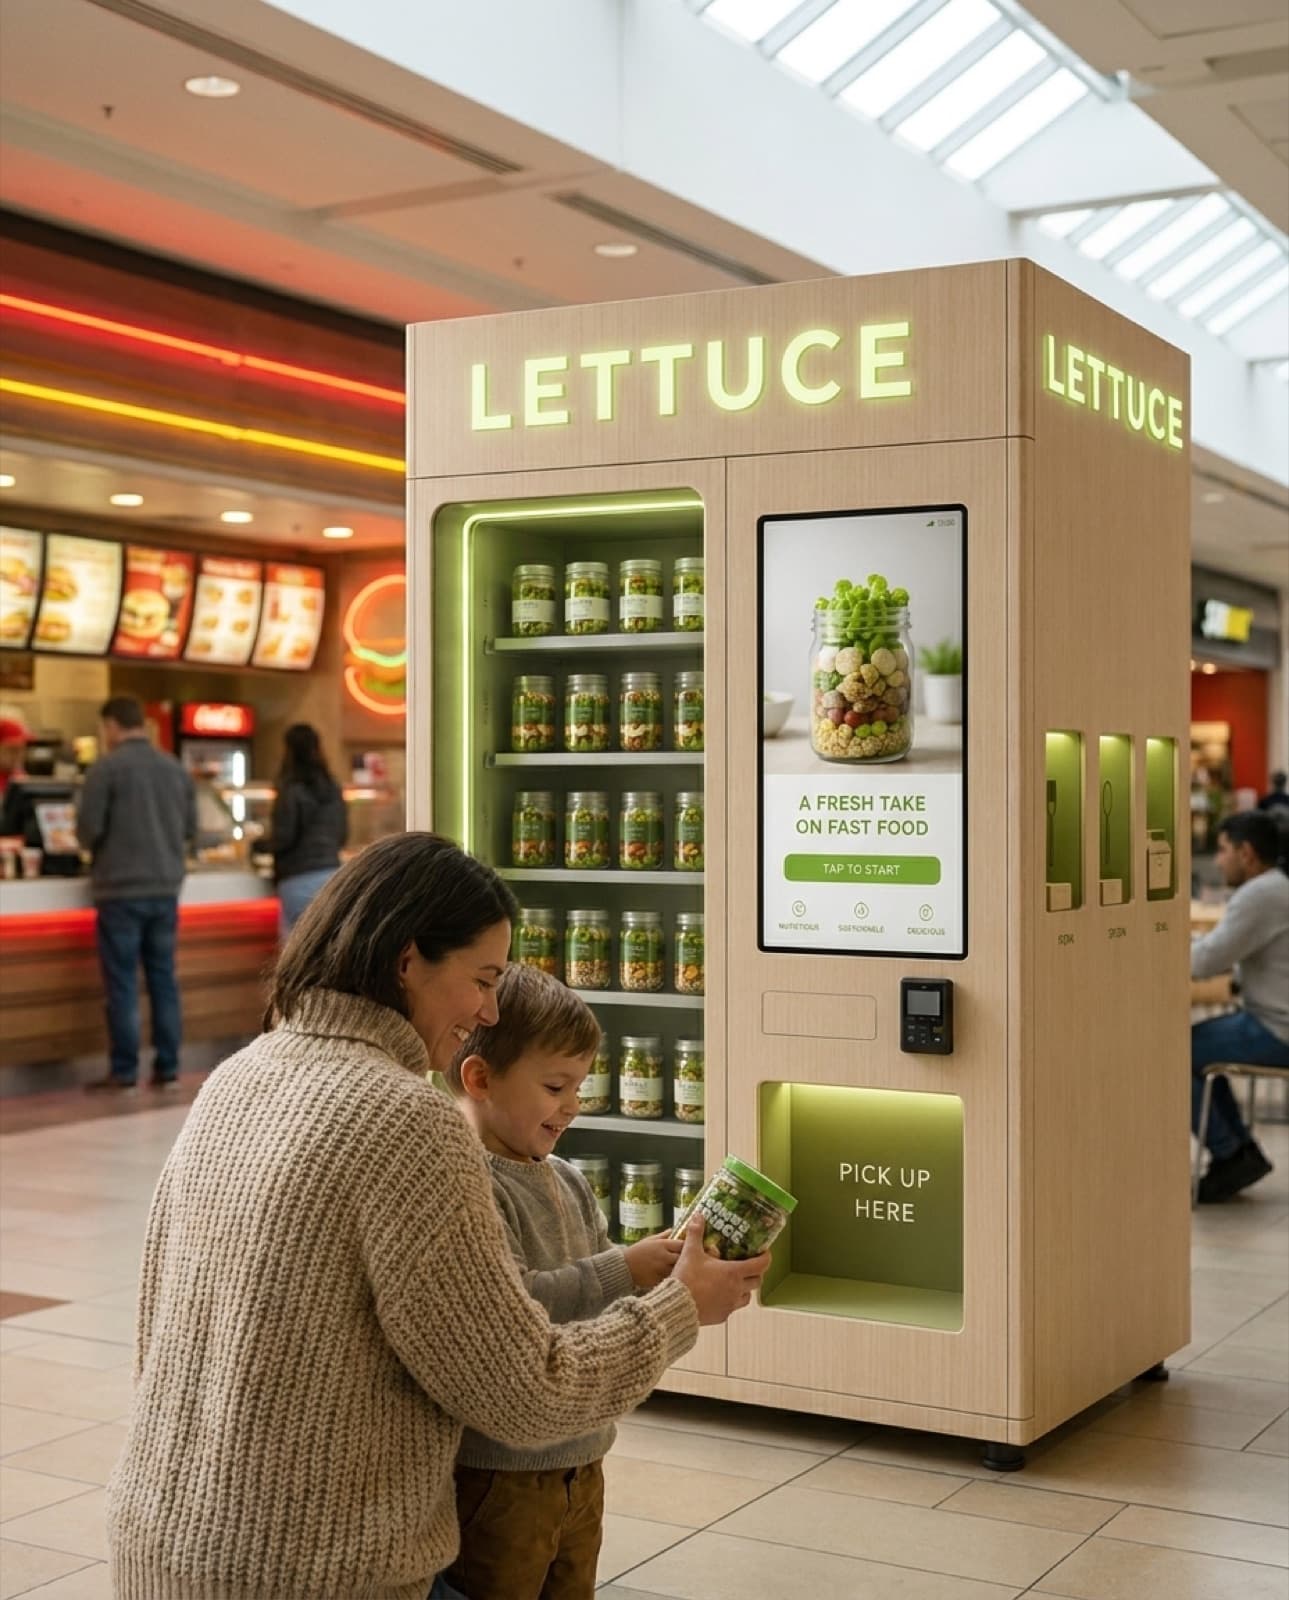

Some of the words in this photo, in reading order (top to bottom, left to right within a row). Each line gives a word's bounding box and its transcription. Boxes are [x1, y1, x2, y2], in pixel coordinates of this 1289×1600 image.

[471, 321, 911, 430] LETTUCE
[1046, 335, 1183, 449] LETTUCE
[799, 795, 811, 811] A
[817, 795, 873, 811] FRESH
[880, 795, 926, 812] TAKE
[796, 819, 822, 835] ON
[828, 819, 872, 835] FAST
[877, 820, 929, 836] FOOD
[823, 863, 844, 875] TAP
[847, 863, 862, 875] TO
[864, 864, 901, 876] START
[840, 1162, 892, 1186] PICK
[900, 1167, 930, 1188] UP
[856, 1198, 915, 1222] HERE
